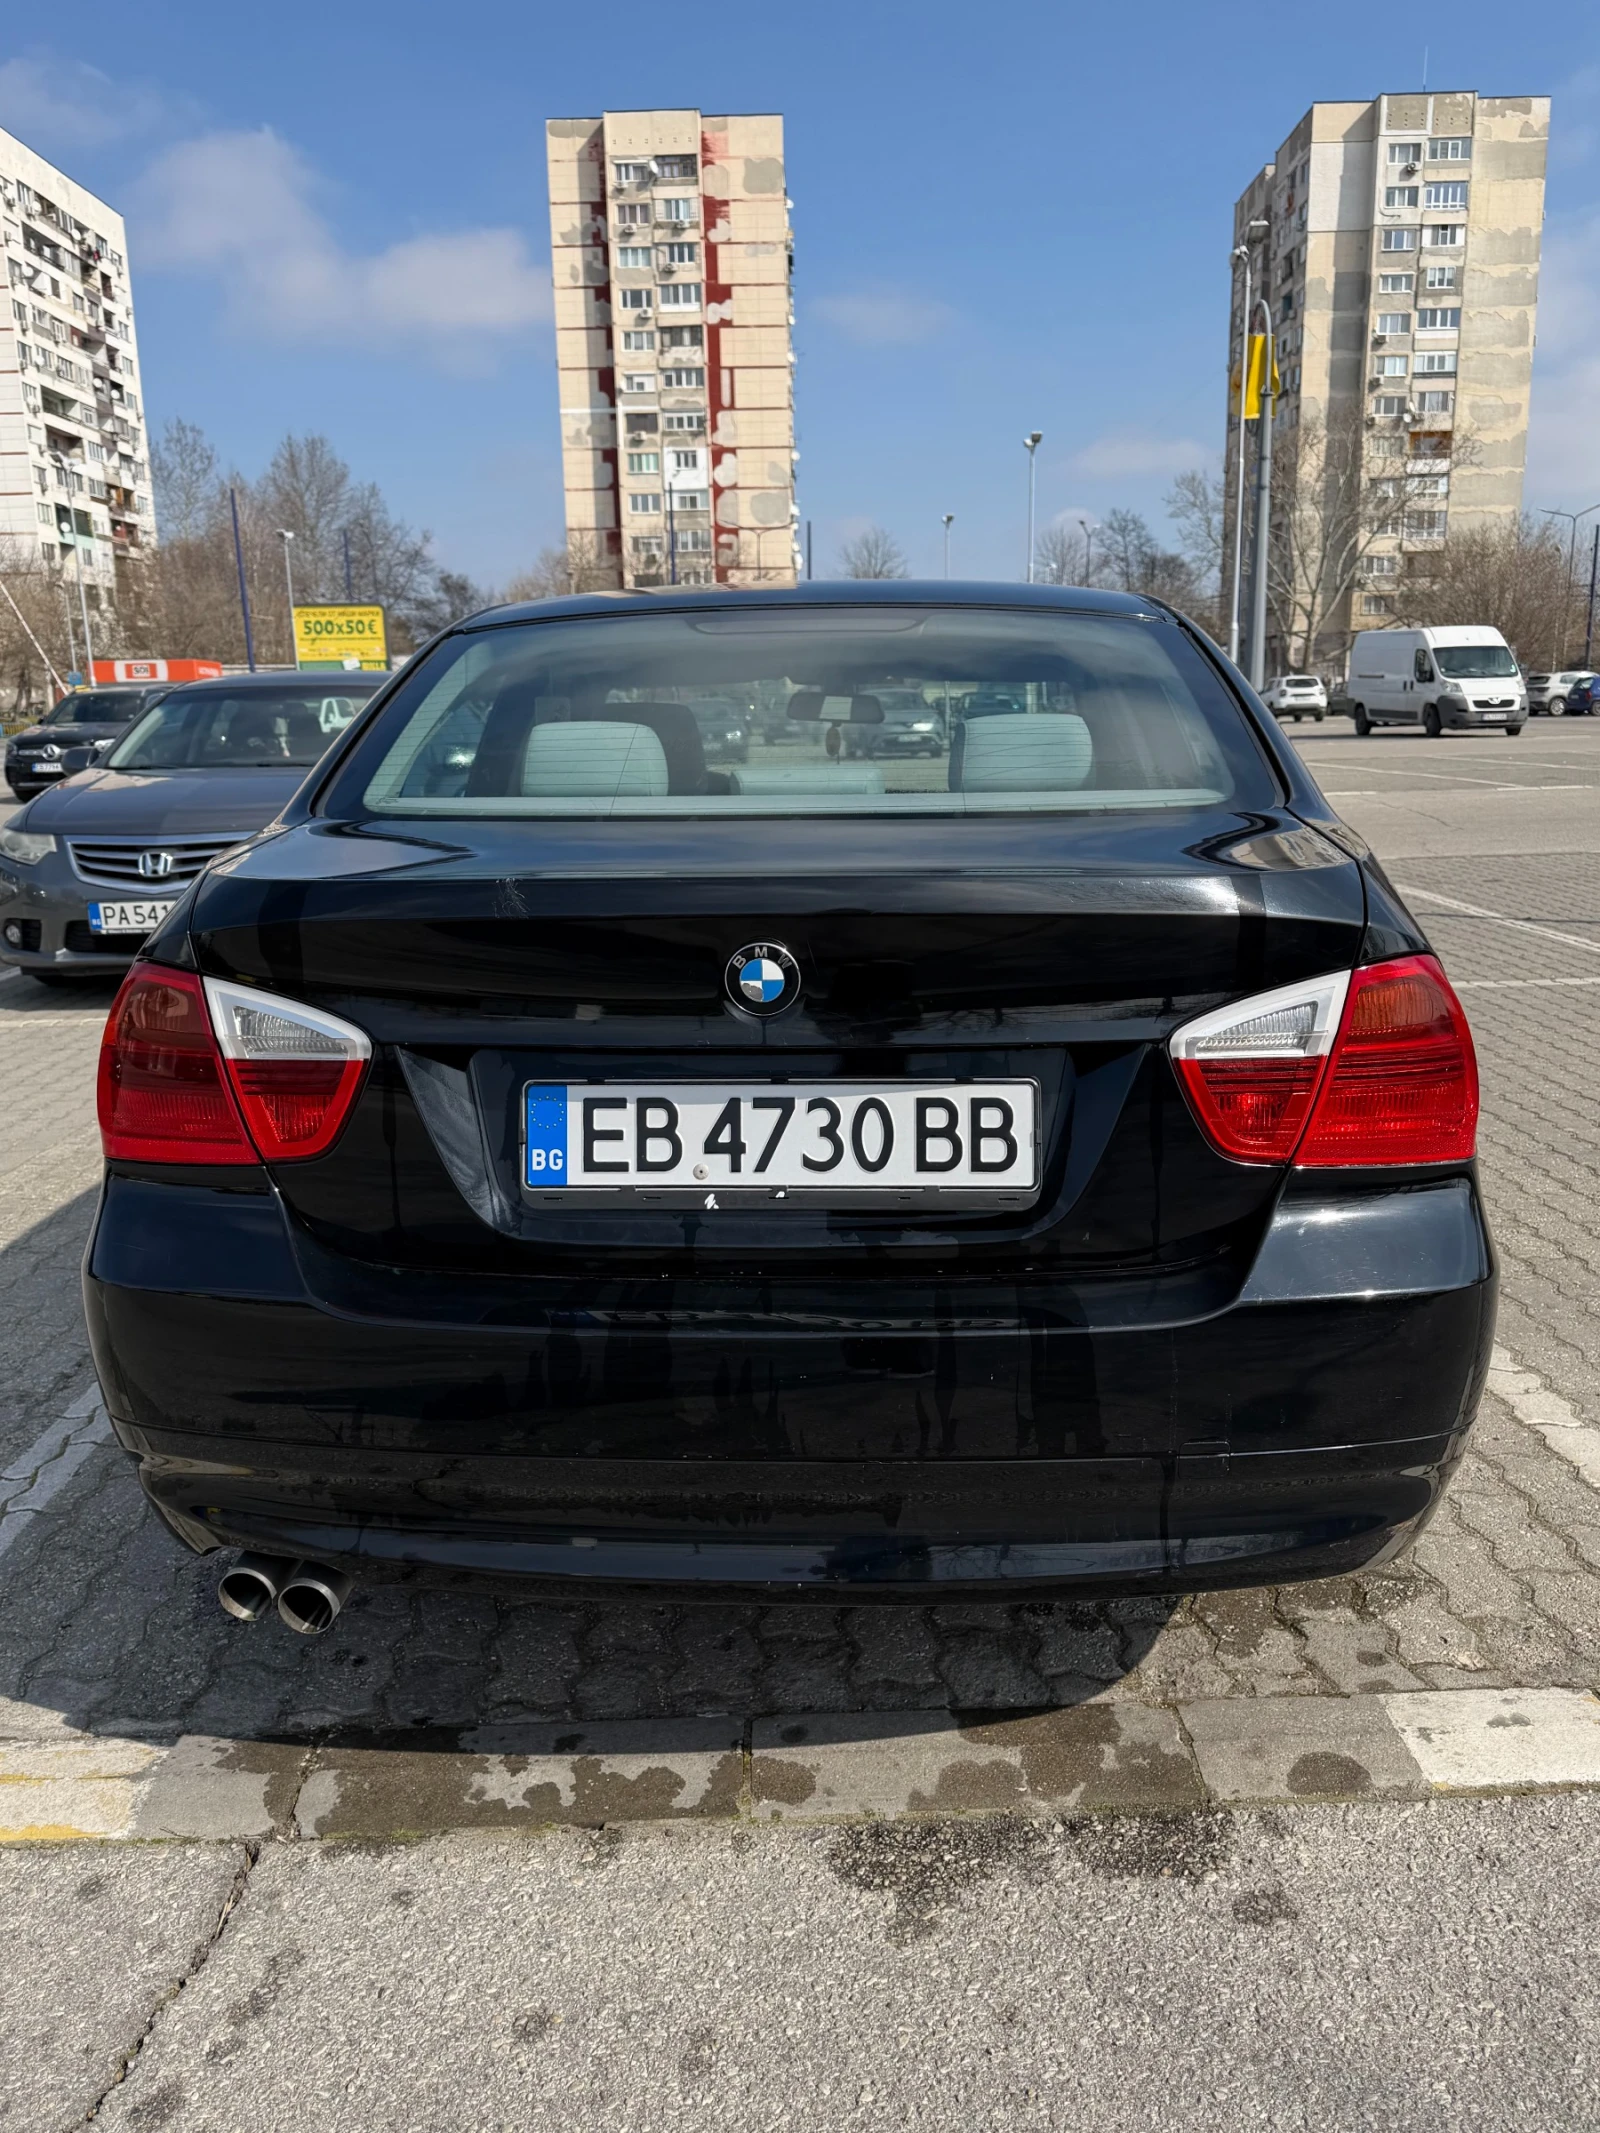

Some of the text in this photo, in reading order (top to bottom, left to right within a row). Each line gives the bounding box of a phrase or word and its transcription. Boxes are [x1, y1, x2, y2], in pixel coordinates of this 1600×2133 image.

[103, 906, 130, 925] PA
[732, 946, 793, 970] BMW
[583, 1097, 1019, 1173] EB 4730 BB
[532, 1148, 563, 1171] BG
